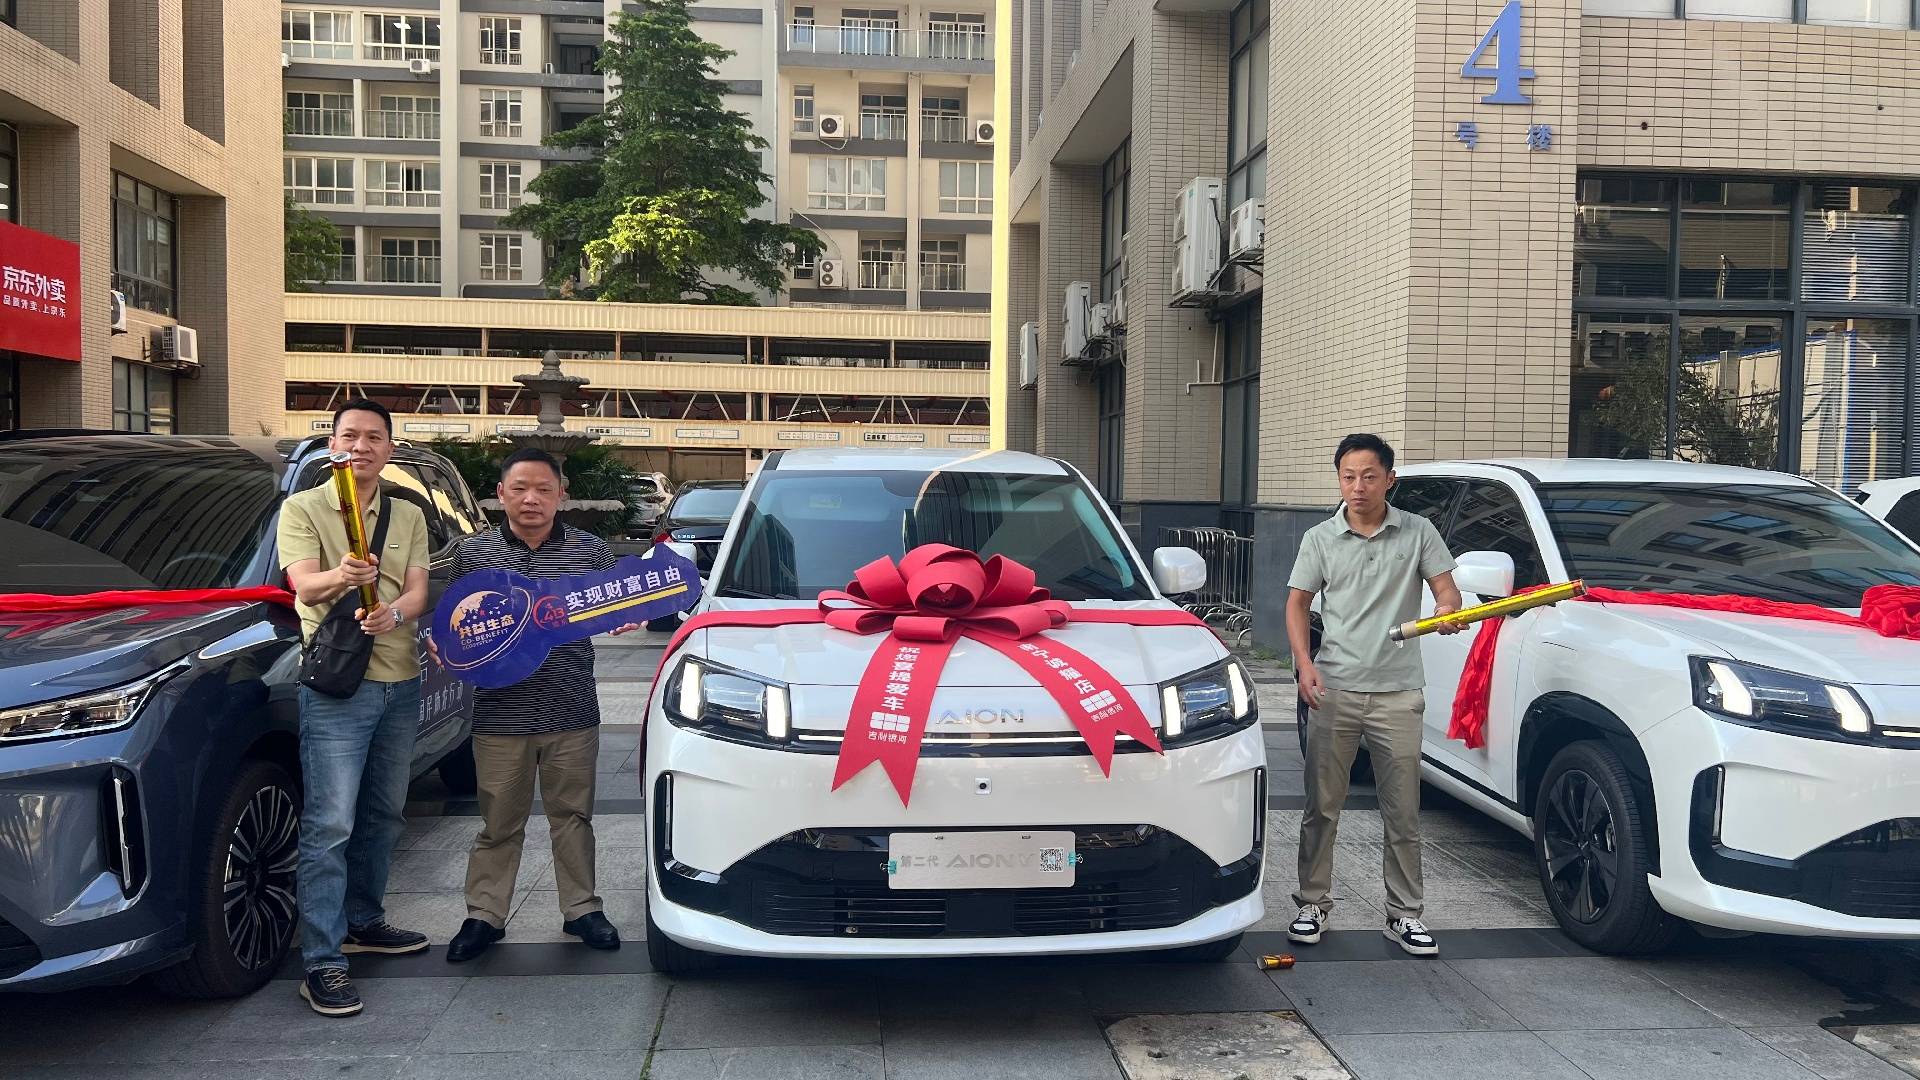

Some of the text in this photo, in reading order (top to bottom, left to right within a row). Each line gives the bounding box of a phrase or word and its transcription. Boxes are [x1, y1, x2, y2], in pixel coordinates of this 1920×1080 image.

[1460, 0, 1536, 105] 4
[1452, 121, 1552, 151] 号楼
[2, 265, 66, 304] 京东外卖
[565, 565, 681, 610] 实现财富自由
[459, 614, 515, 638] 共益生态
[881, 646, 921, 711] 祝您喜提爱车
[935, 708, 1025, 725] AION
[868, 730, 908, 745] 吉利银河
[900, 854, 939, 869] 第二代
[945, 853, 1015, 869] AION
